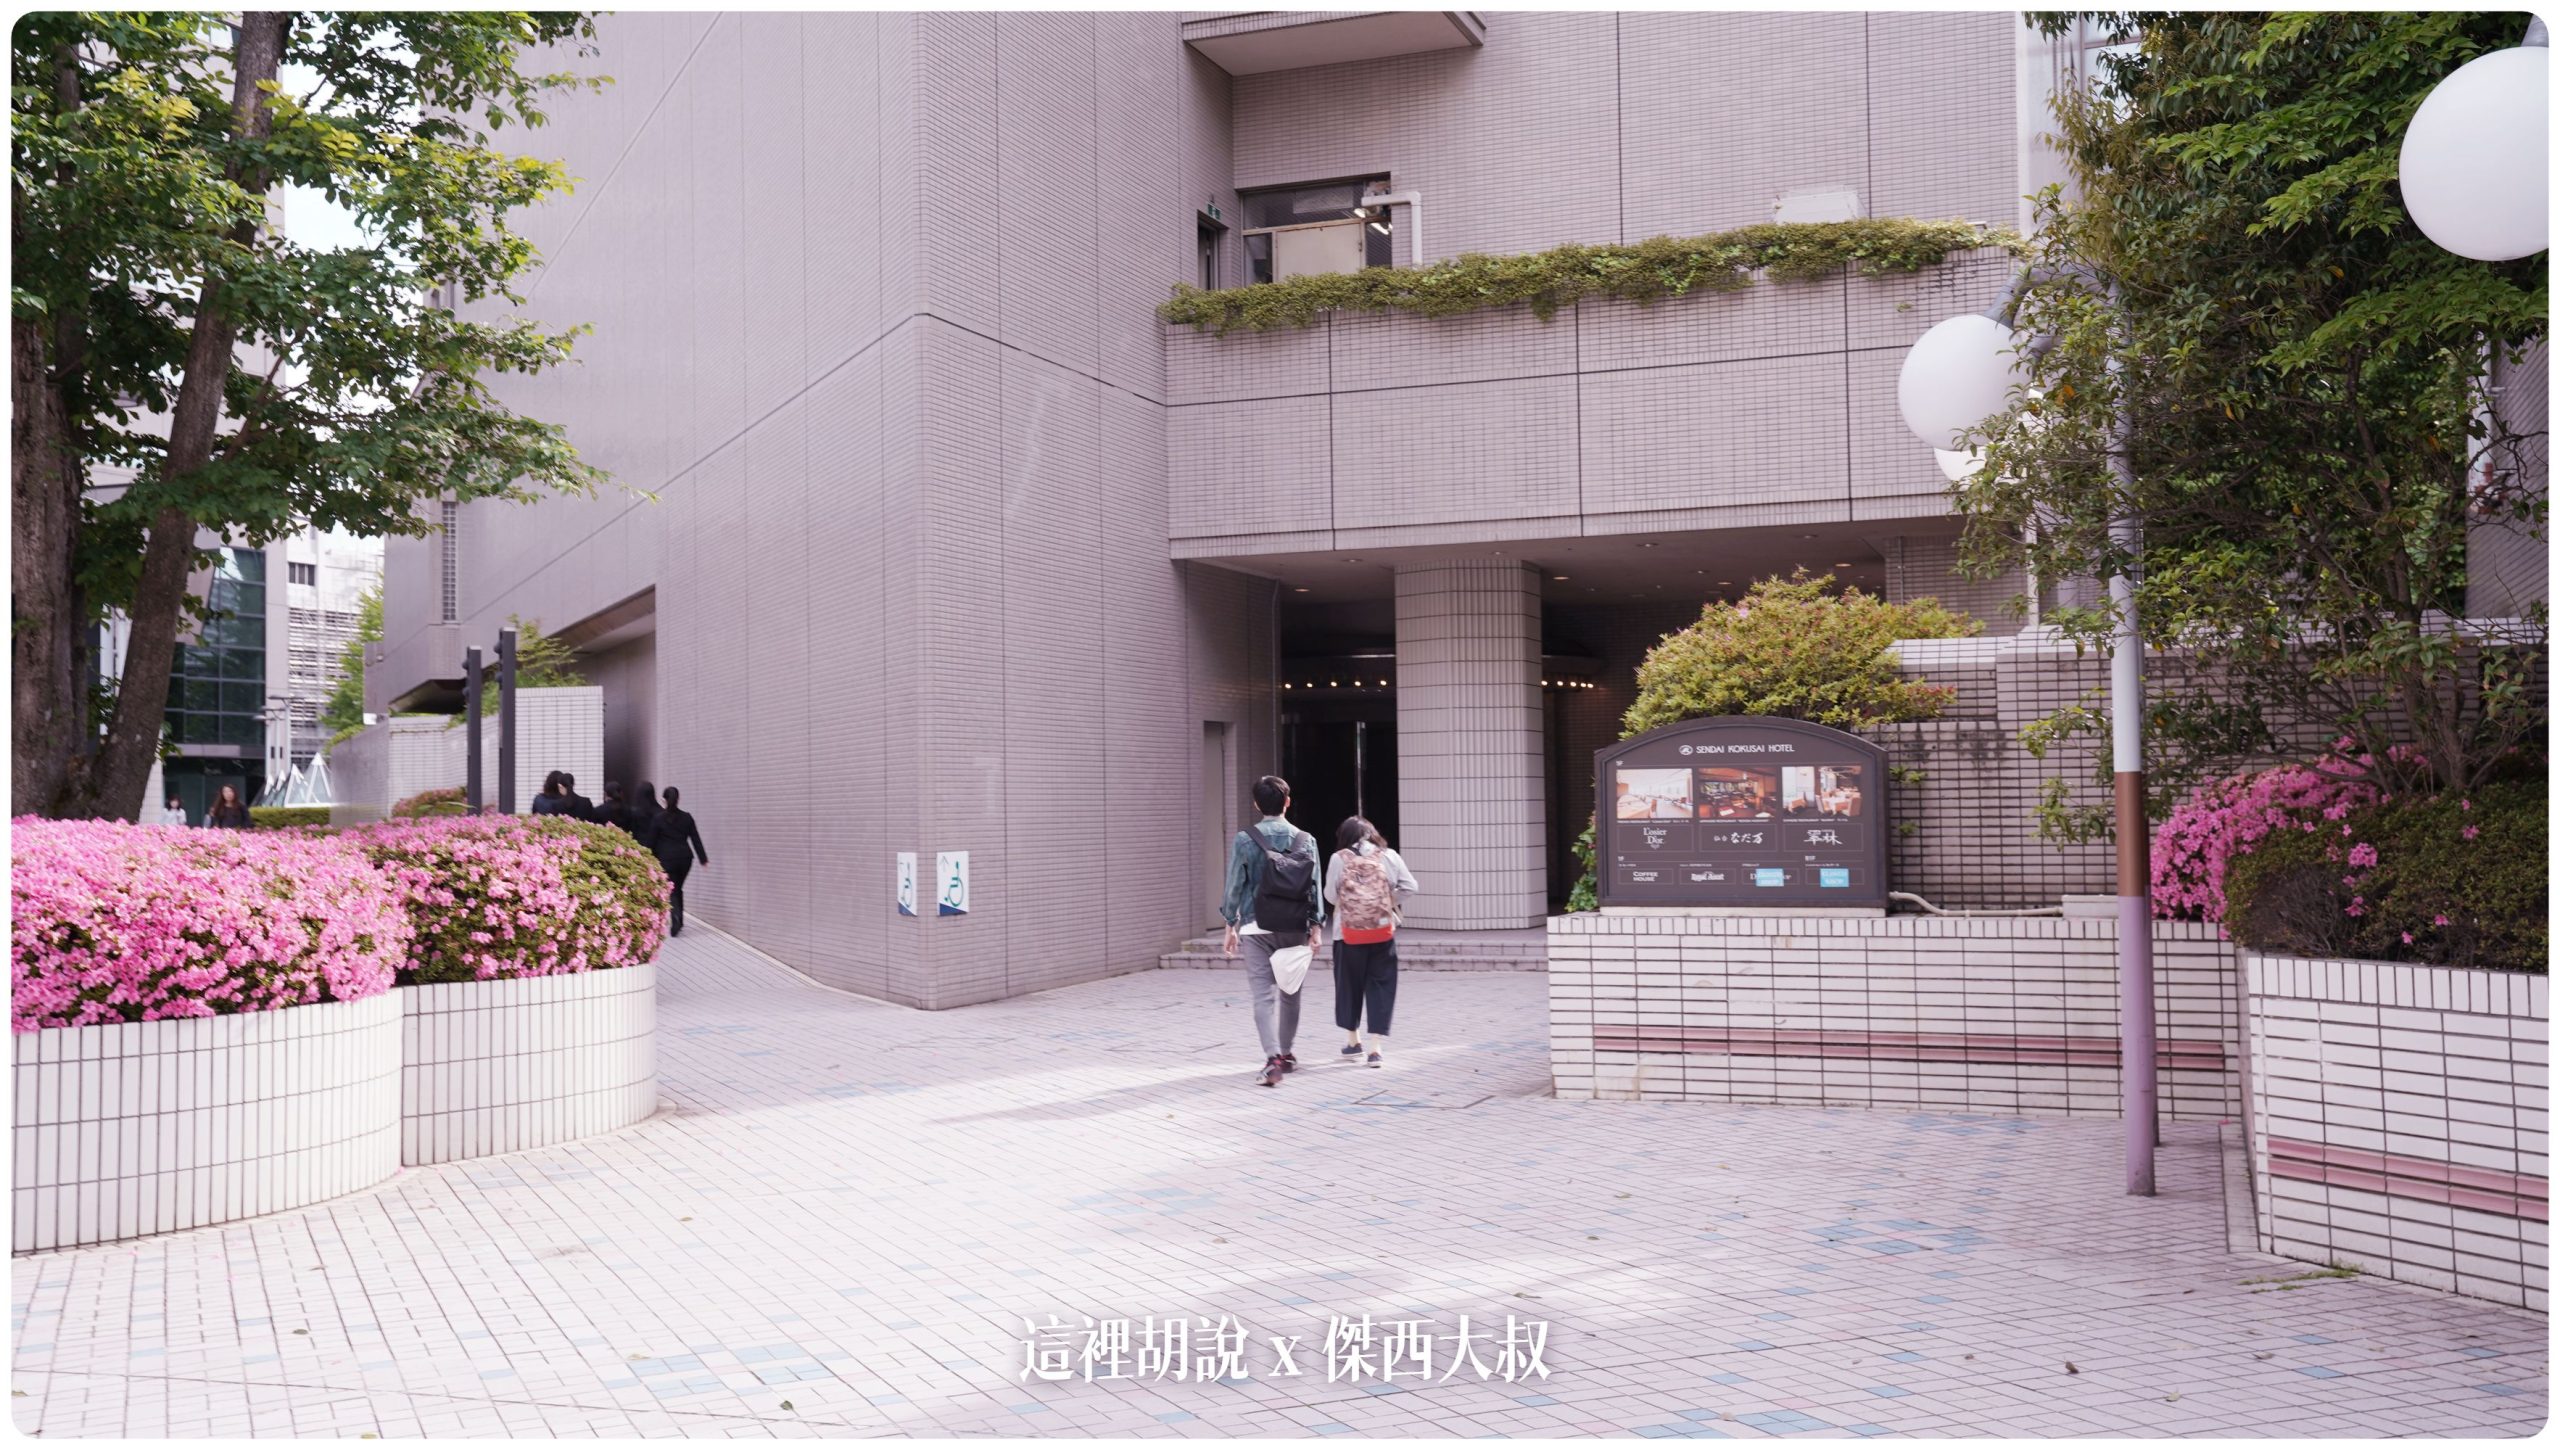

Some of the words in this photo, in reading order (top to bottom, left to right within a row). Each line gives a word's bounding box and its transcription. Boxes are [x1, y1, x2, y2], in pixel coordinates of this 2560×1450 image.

[1696, 745, 1724, 754] SENDAI
[1728, 744, 1765, 753] KOKUSAI
[1768, 744, 1795, 753] HOTEL
